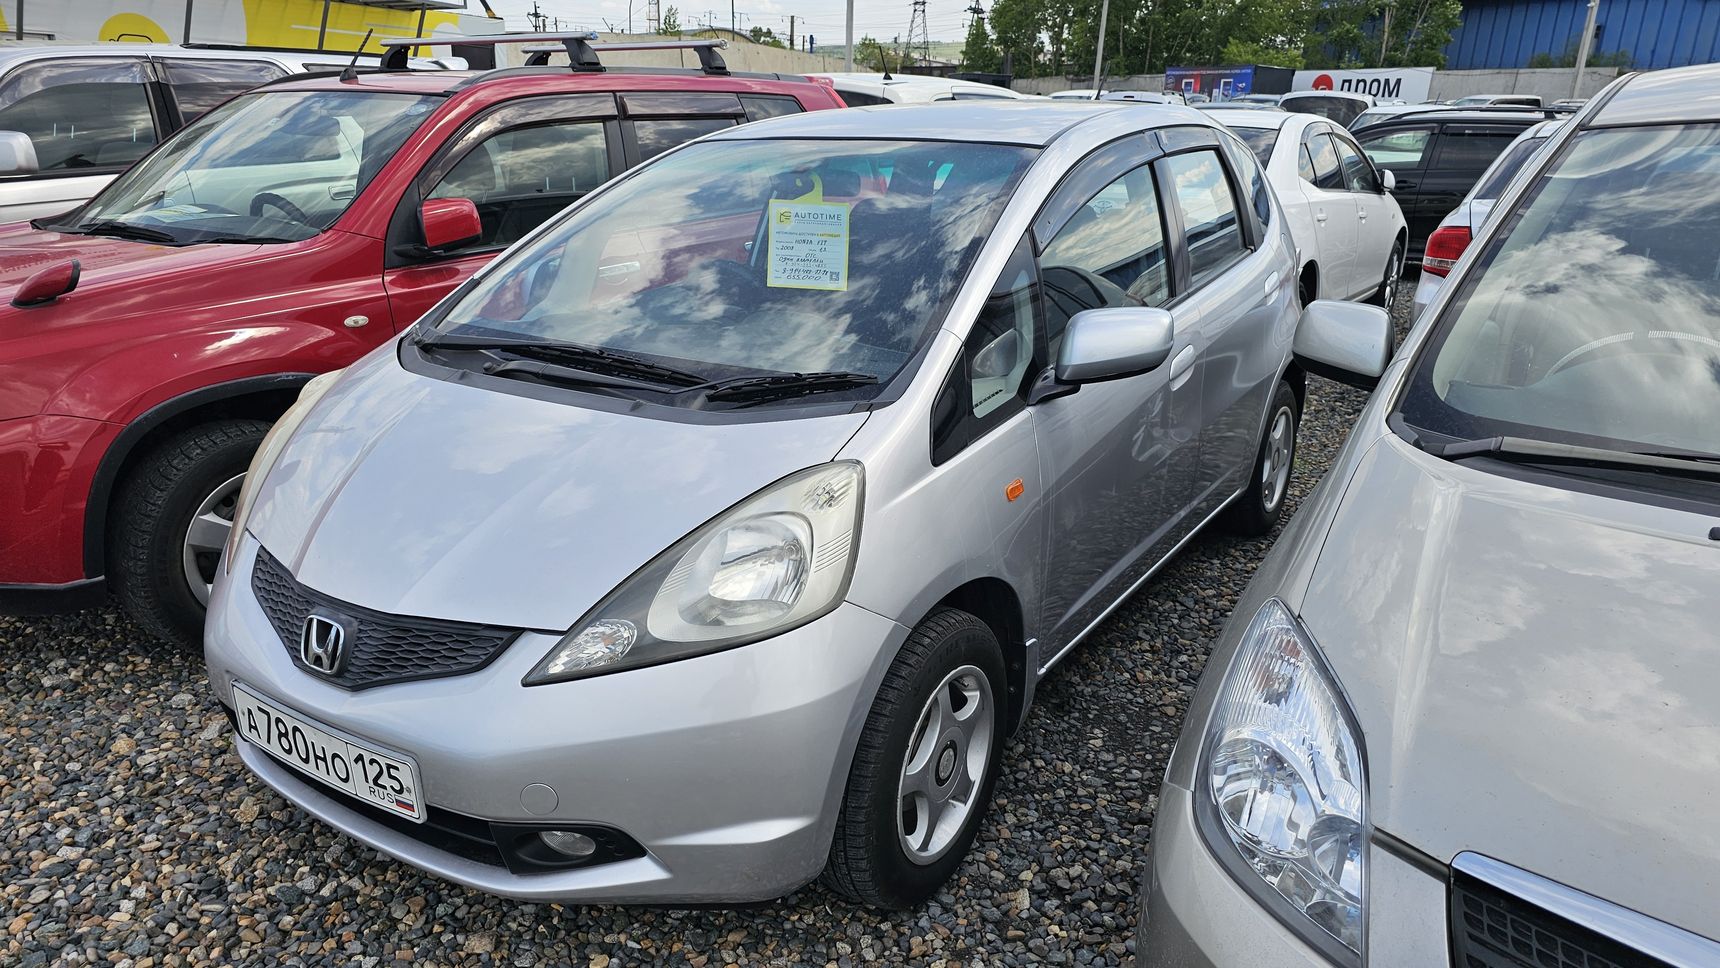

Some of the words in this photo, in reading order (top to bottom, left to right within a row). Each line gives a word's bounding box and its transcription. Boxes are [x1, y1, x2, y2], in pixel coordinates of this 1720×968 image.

[794, 212, 842, 221] AUTOTIME
[353, 753, 405, 795] 125
[368, 785, 395, 804] RUS
